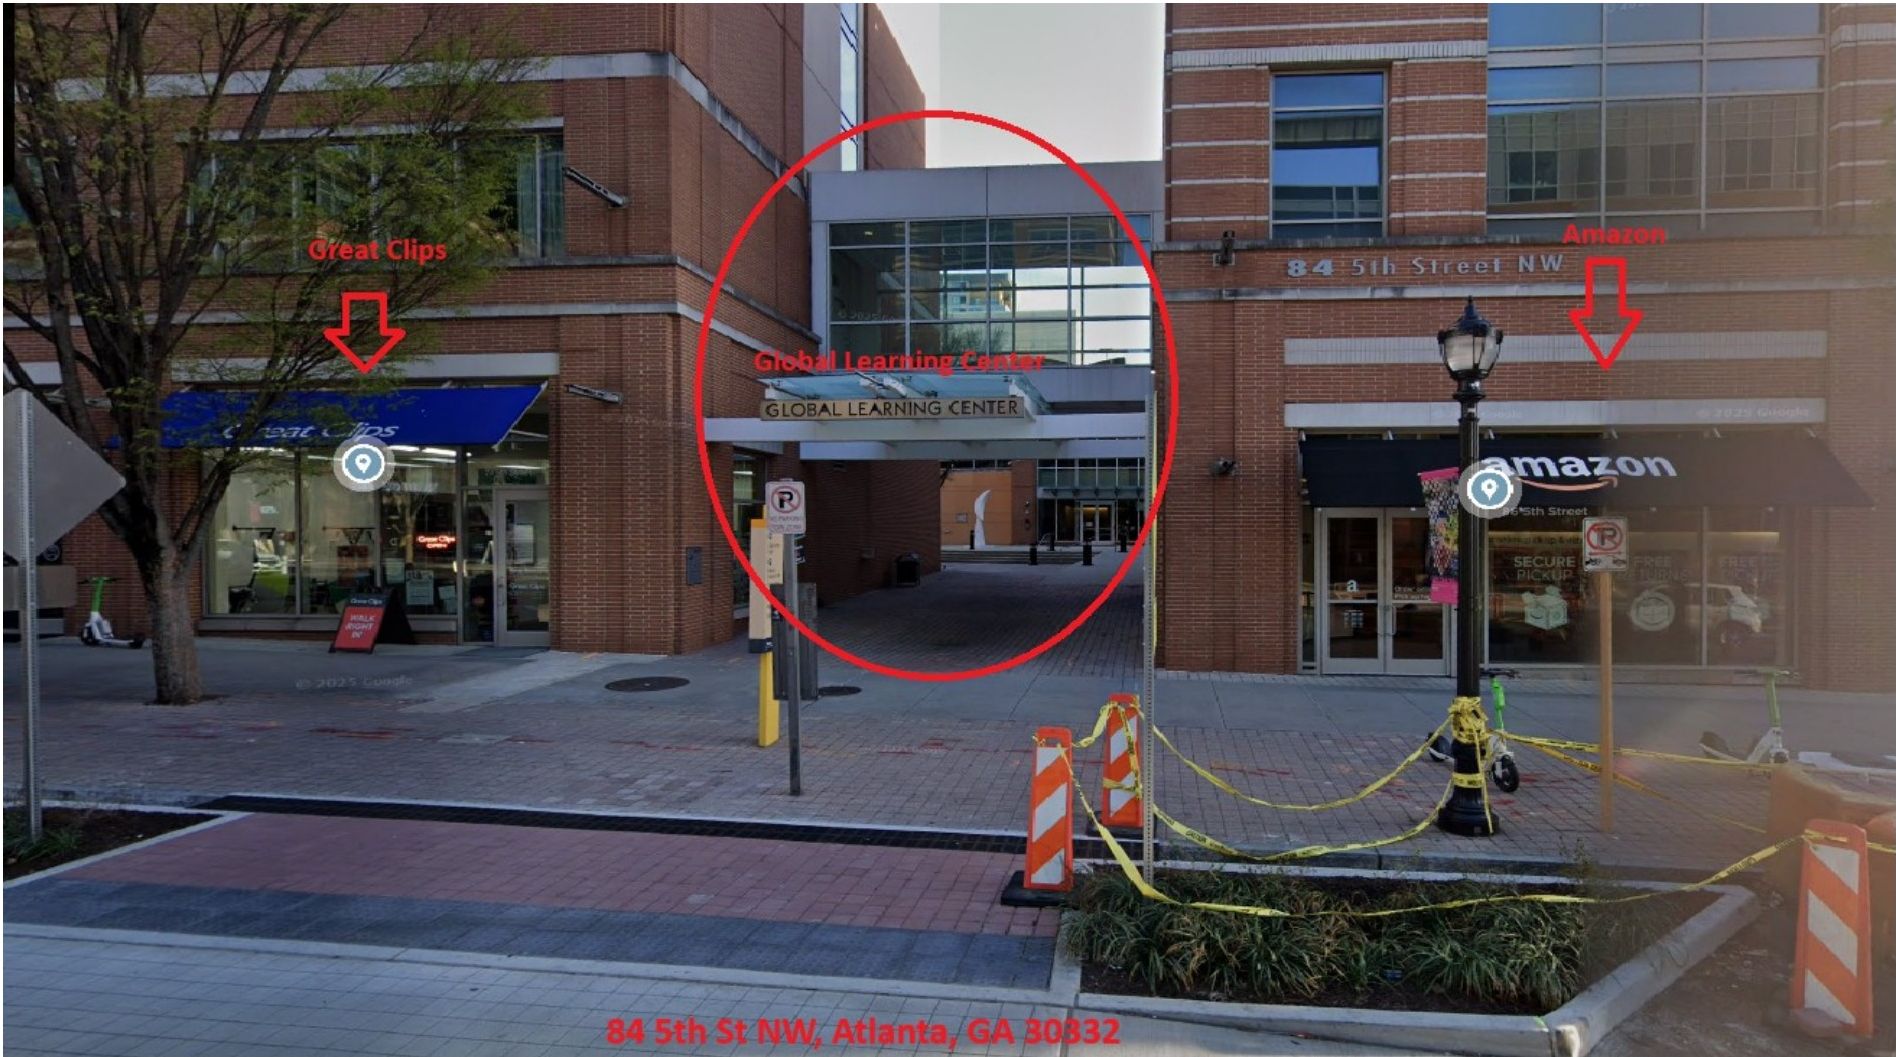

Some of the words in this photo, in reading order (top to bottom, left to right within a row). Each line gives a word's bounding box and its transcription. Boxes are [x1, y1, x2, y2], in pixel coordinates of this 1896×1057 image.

[1287, 258, 1334, 277] 84
[1351, 256, 1396, 276] 5th
[1411, 255, 1502, 276] Street
[1518, 253, 1564, 274] NW
[765, 403, 843, 419] GLOBAL
[849, 400, 942, 417] LEARNING
[949, 399, 1018, 415] CENTER
[1480, 456, 1677, 477] amazon
[1548, 506, 1588, 516] Street
[1514, 556, 1576, 568] SECURE
[1517, 569, 1573, 581] PICKUP
